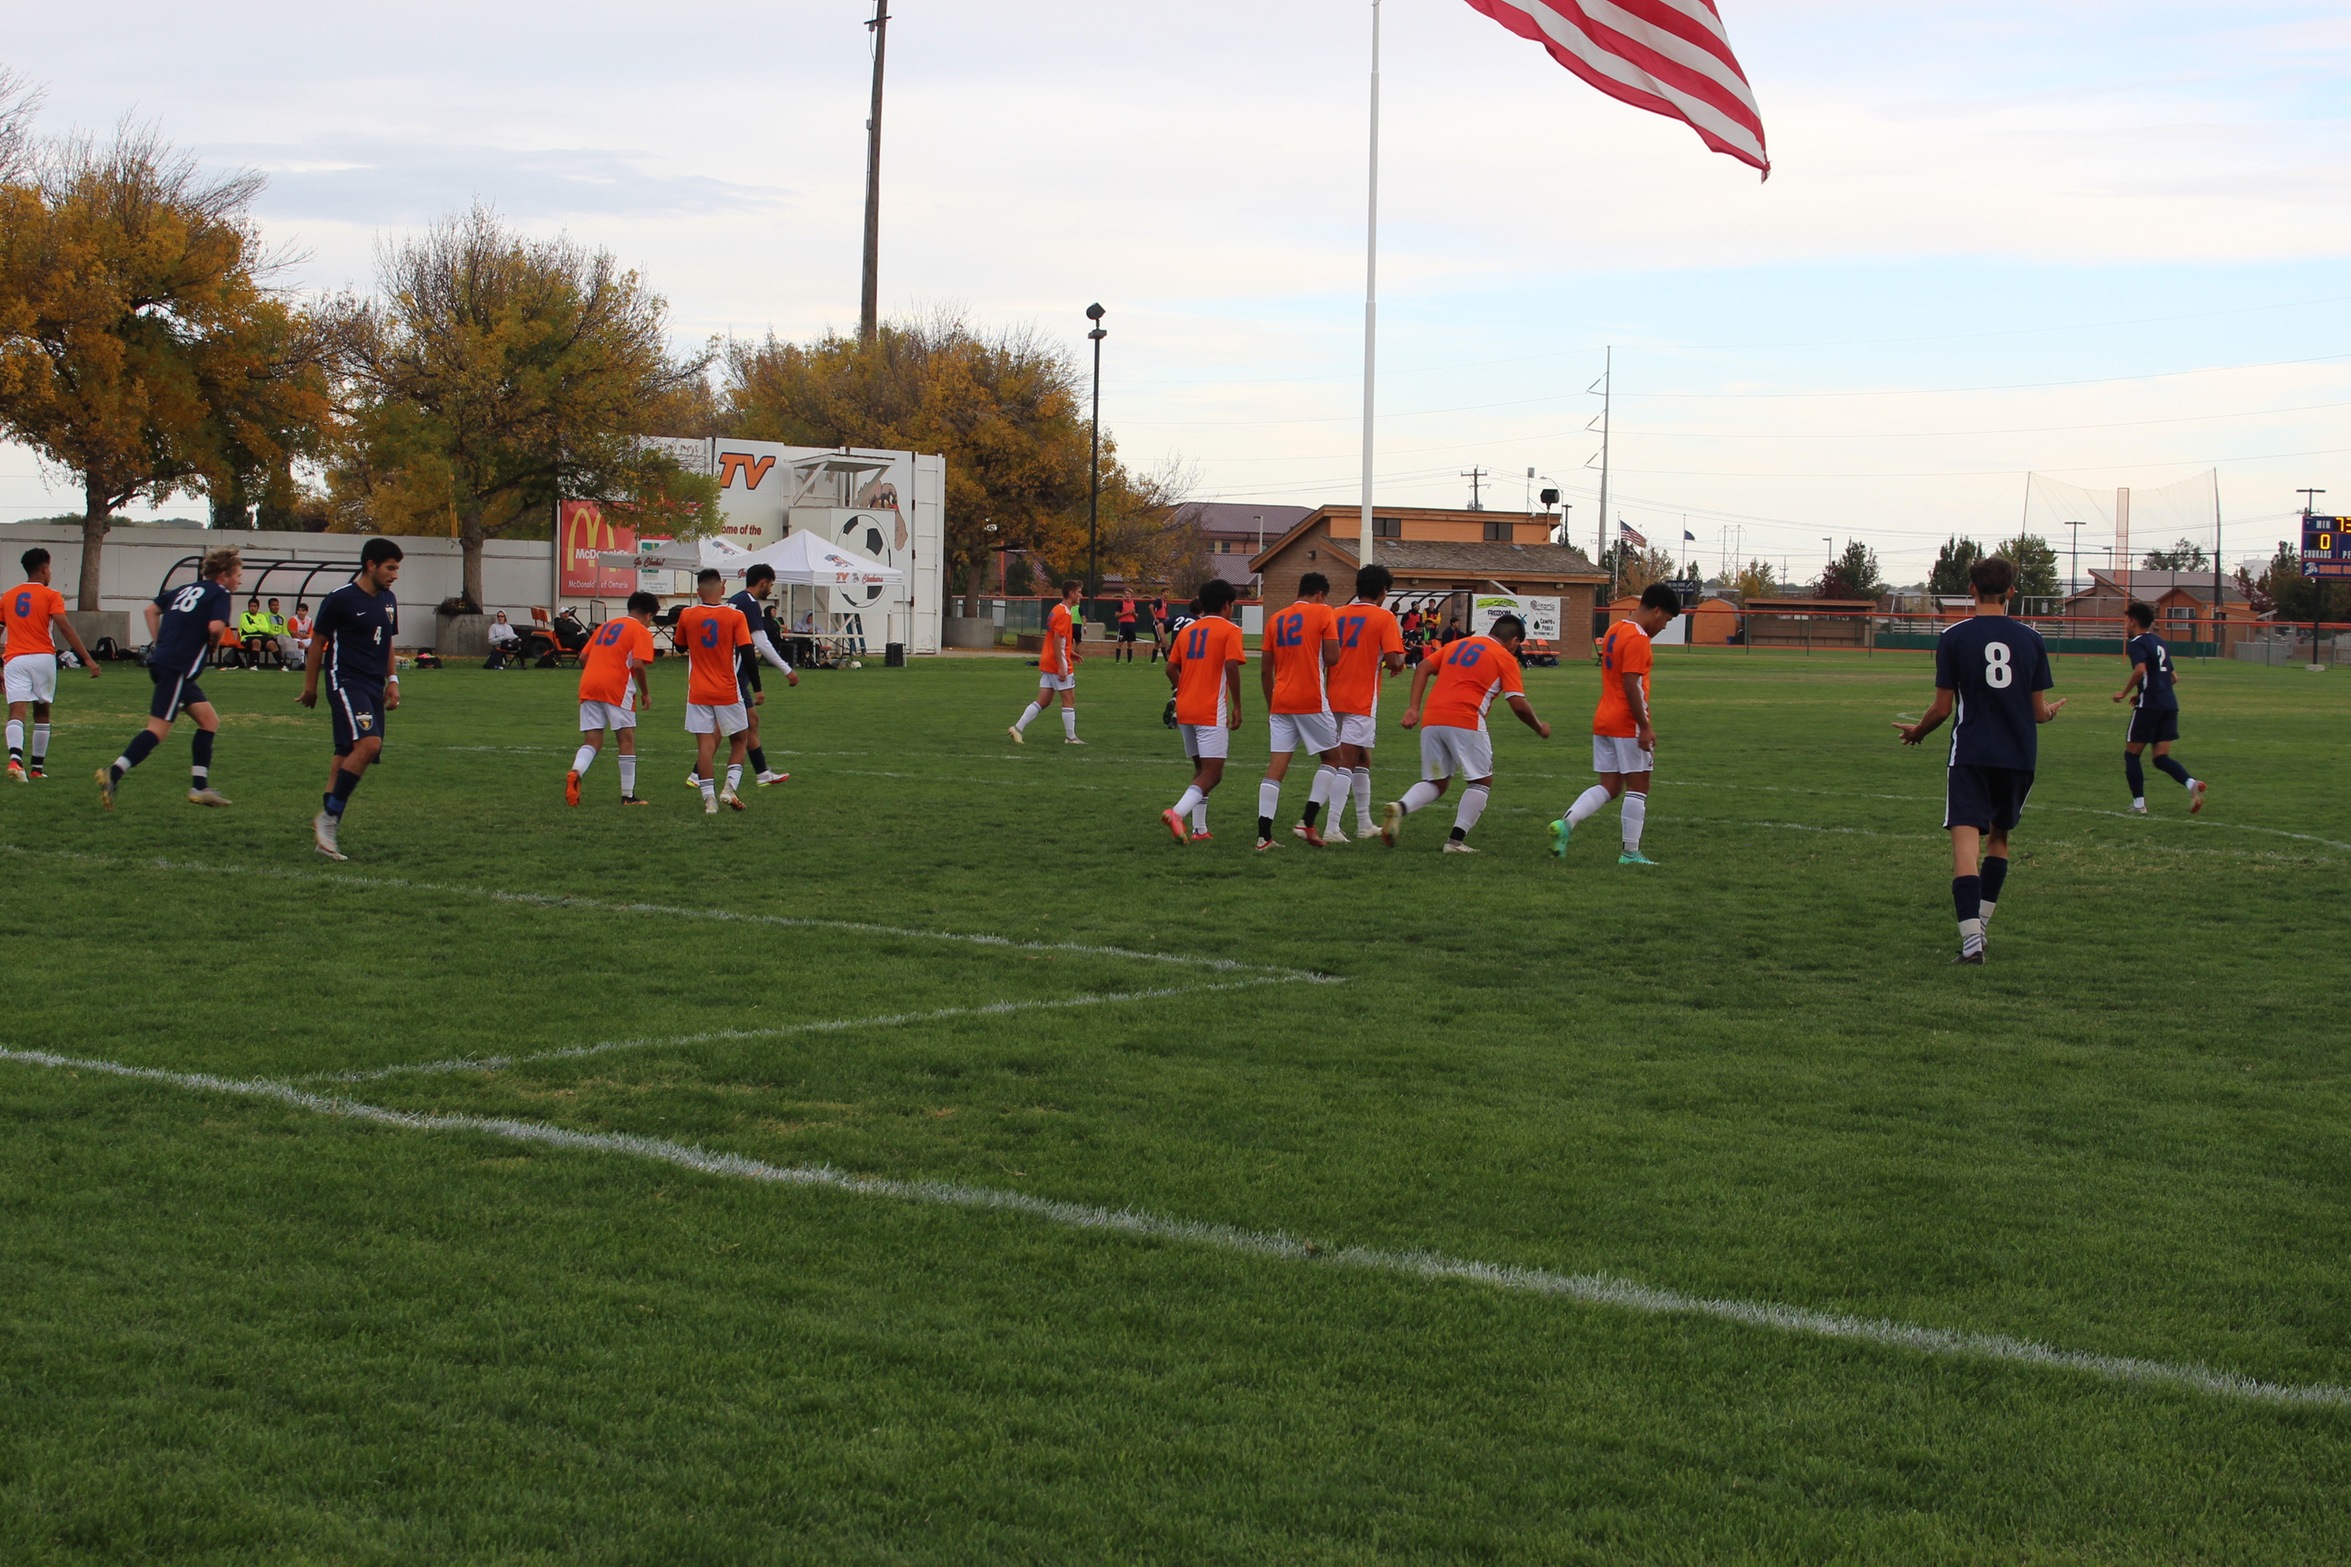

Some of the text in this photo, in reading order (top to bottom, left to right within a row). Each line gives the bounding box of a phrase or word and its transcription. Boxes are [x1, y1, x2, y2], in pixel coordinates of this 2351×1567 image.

[718, 452, 776, 490] TV
[721, 524, 762, 536] ome of the
[2320, 534, 2331, 550] 0
[568, 580, 597, 588] McDonald'
[836, 572, 849, 581] TV
[15, 592, 31, 618] 6
[170, 585, 206, 613] 28
[373, 626, 382, 646] 4
[595, 622, 624, 646] 19
[701, 618, 718, 649] 3
[1276, 612, 1304, 647] 12
[1338, 616, 1367, 648] 17
[1187, 628, 1209, 660] 11
[1447, 641, 1487, 668] 16
[1984, 641, 2012, 689] 8
[2156, 644, 2168, 672] 2
